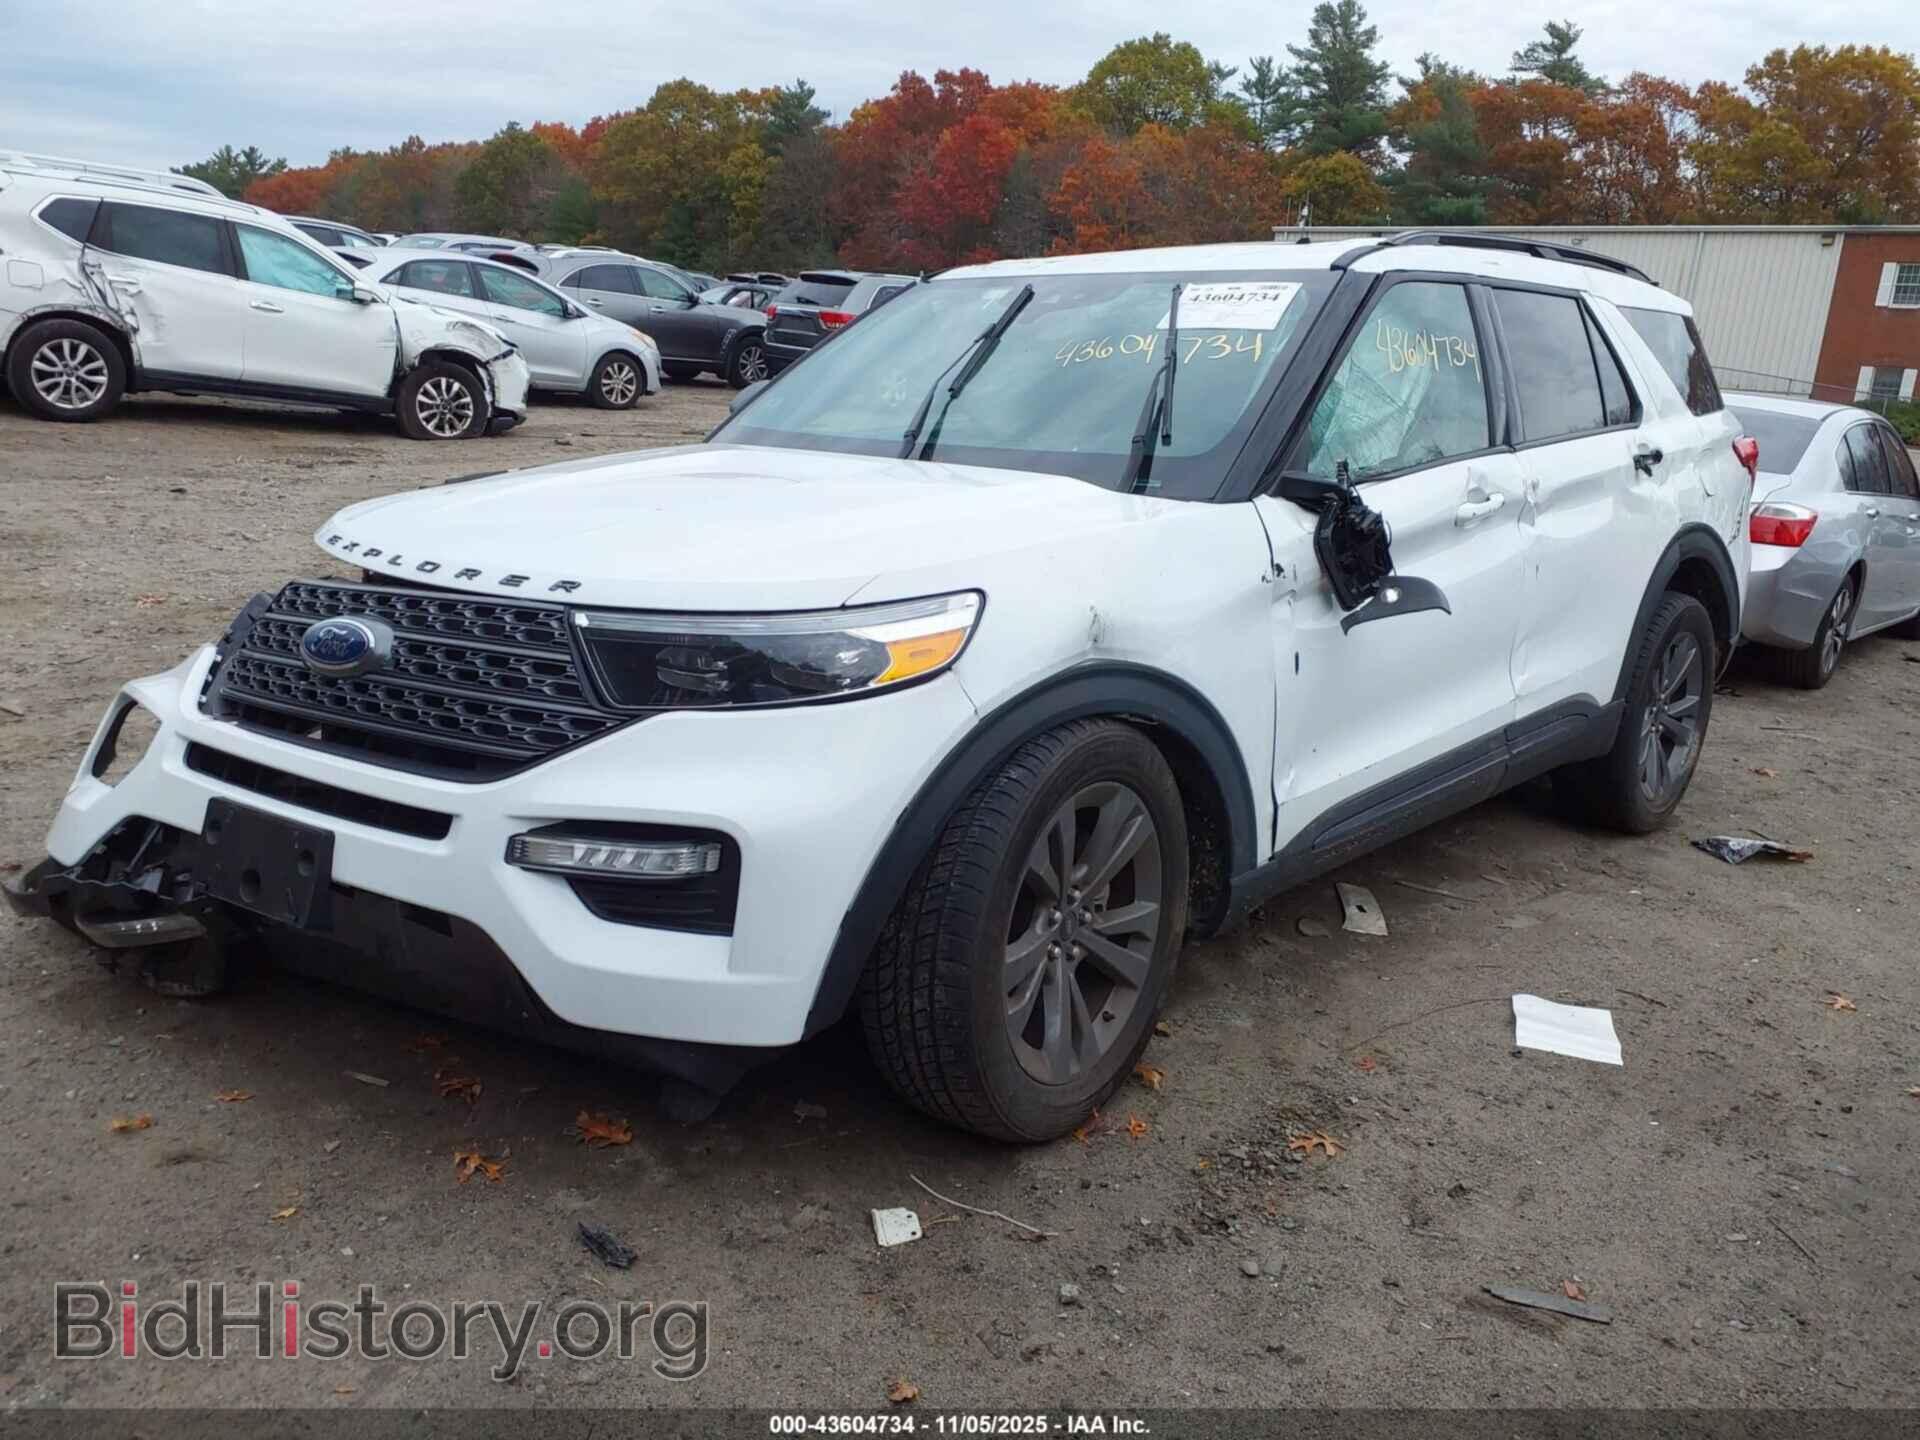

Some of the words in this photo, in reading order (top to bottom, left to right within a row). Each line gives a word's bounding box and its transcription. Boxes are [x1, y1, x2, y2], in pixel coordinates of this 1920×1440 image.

[1191, 291, 1280, 302] 43604734
[1376, 319, 1480, 383] 43604734
[326, 533, 582, 594] EXPLORER
